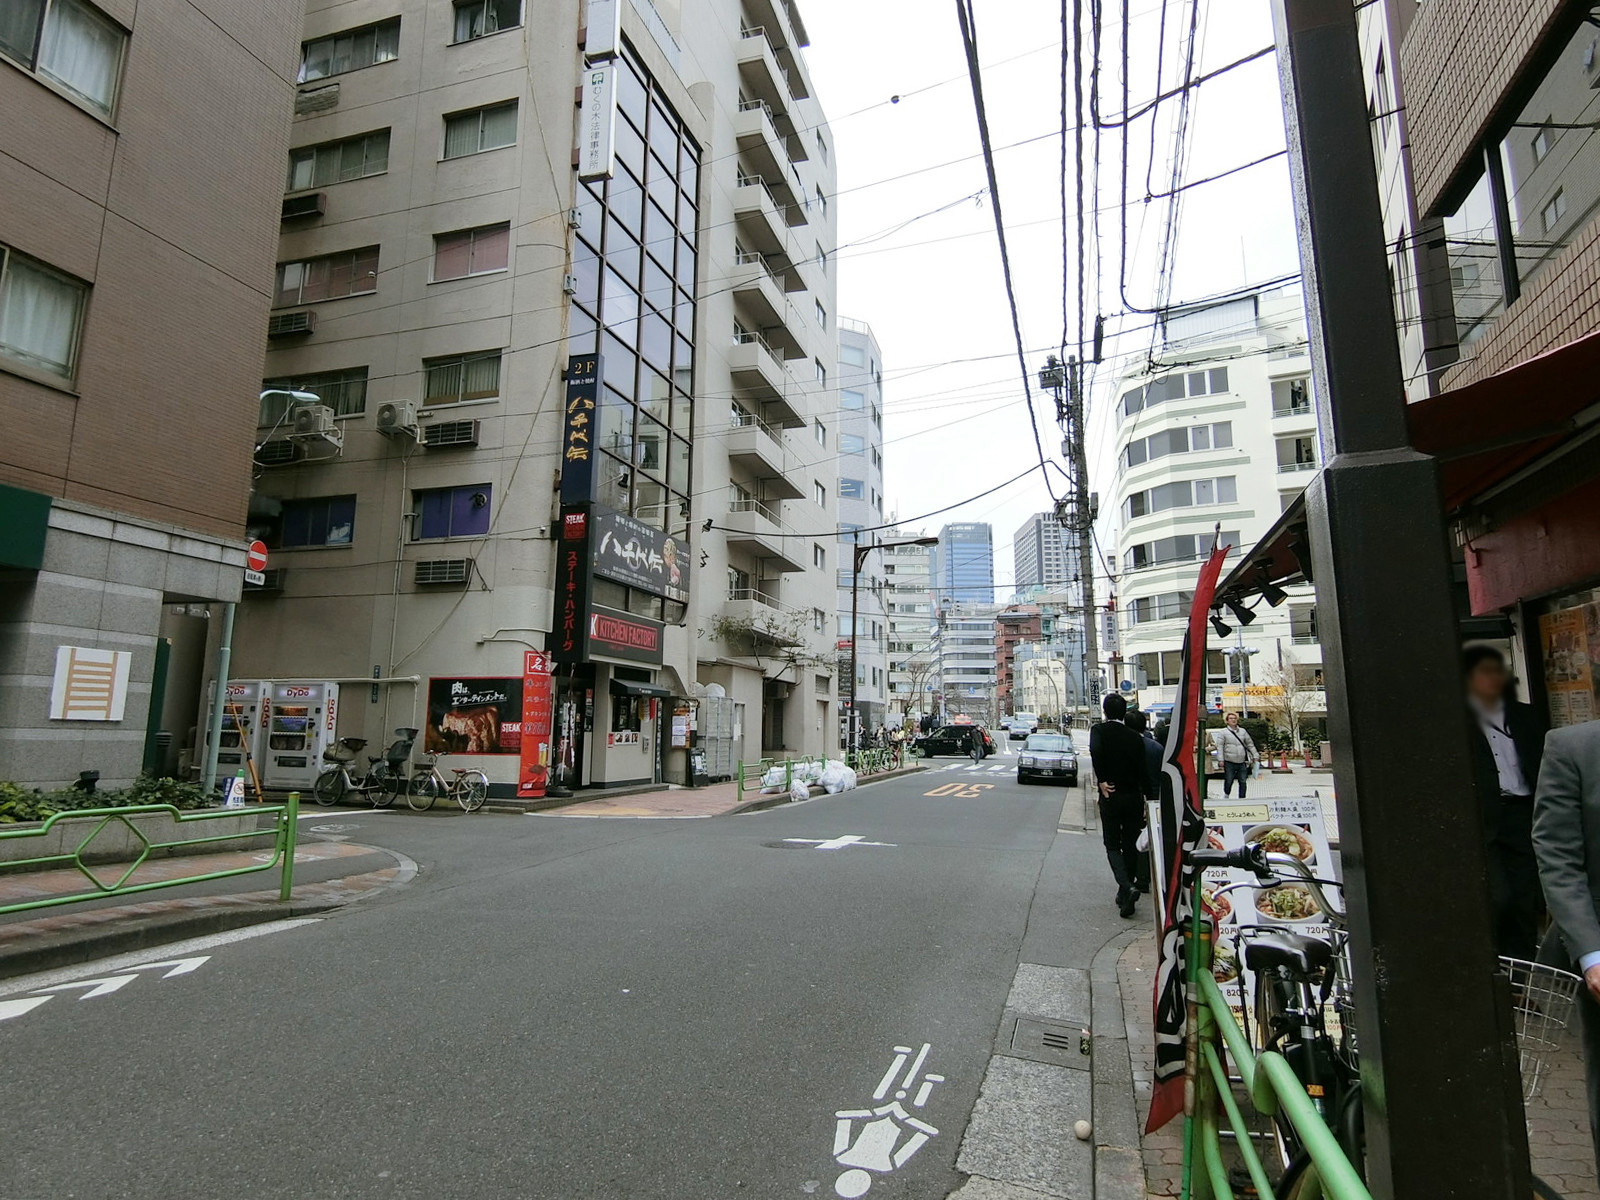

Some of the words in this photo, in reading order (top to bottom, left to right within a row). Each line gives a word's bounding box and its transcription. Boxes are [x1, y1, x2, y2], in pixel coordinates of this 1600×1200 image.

[589, 86, 601, 170] むくの木法律事務所
[565, 513, 585, 525] STEAK
[563, 551, 577, 651] ステーキ・ハンバーグ
[600, 618, 628, 643] KITCHEN
[629, 626, 656, 647] FACTORY
[286, 689, 309, 698] DyDo
[262, 697, 270, 728] DyDo
[327, 699, 335, 730] DyDo
[502, 723, 521, 733] STEAK
